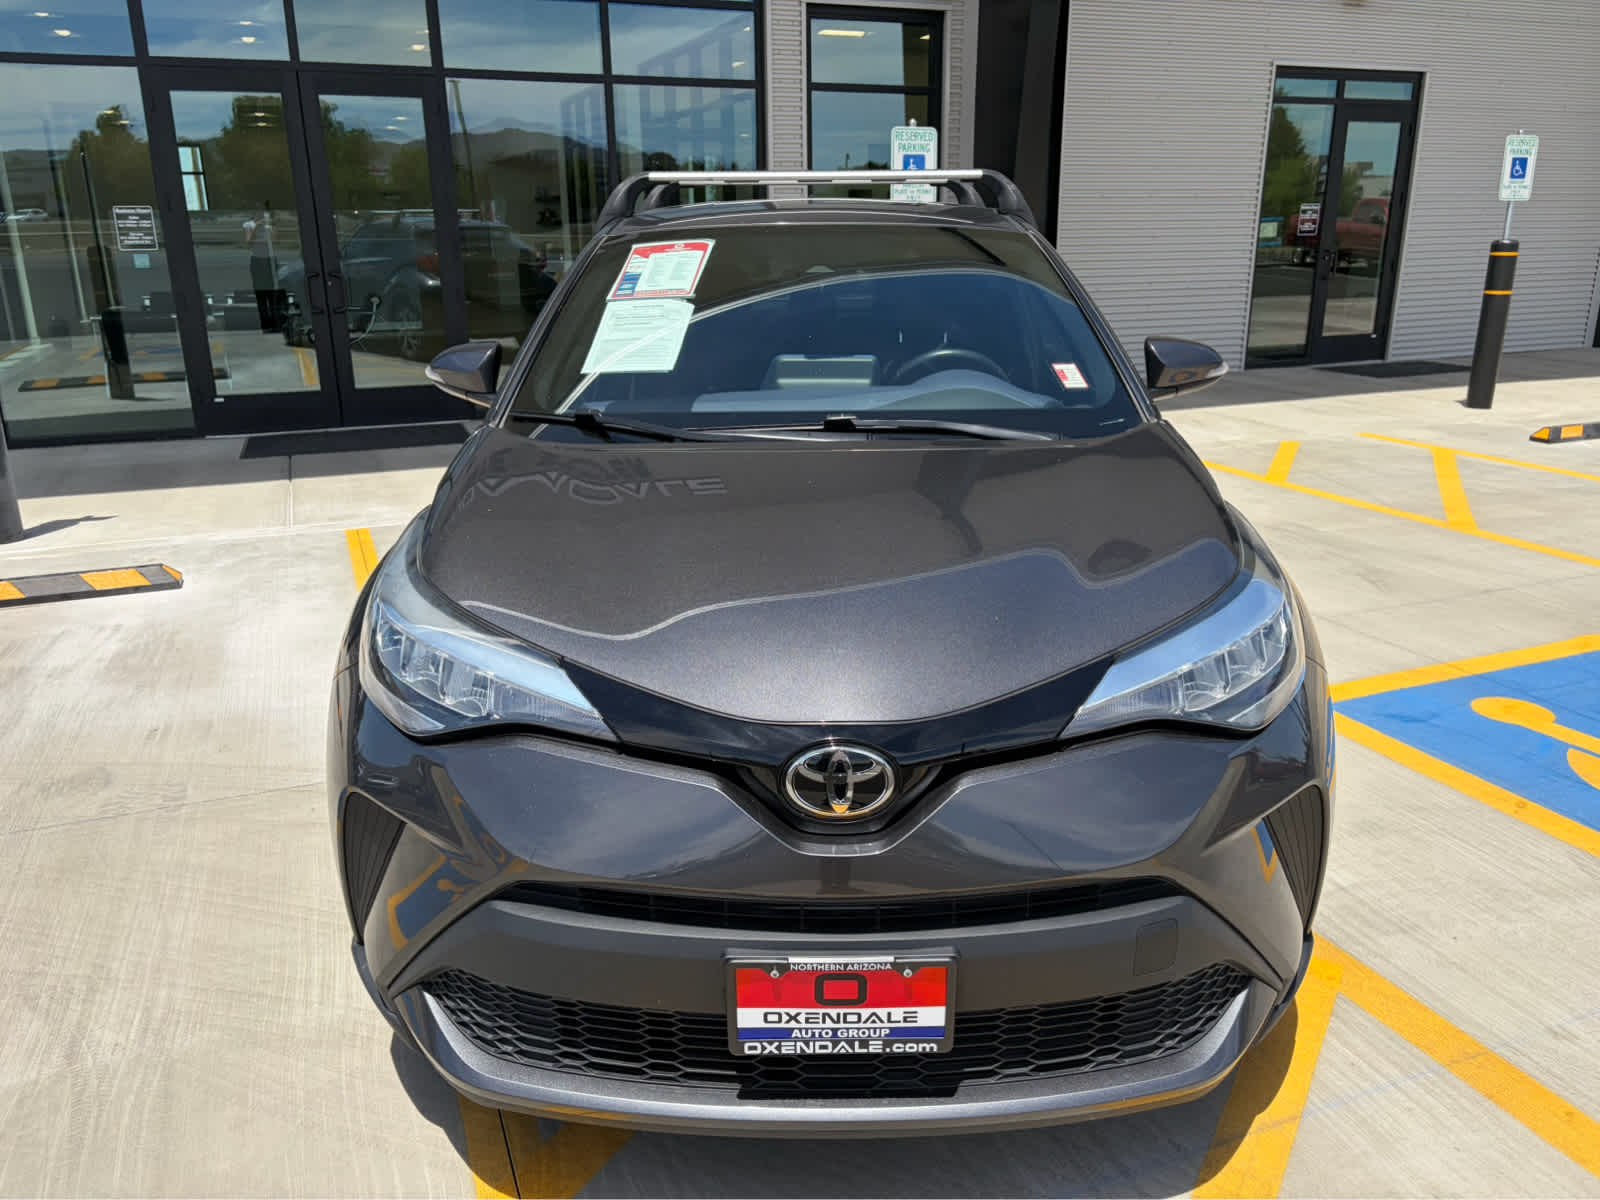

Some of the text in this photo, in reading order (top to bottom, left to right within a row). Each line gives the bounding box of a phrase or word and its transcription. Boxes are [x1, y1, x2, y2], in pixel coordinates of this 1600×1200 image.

[895, 131, 933, 141] RESERVED
[898, 143, 931, 153] PARKING
[789, 962, 893, 972] NORTHERN ARIZONA
[763, 1011, 918, 1025] OXENDALE
[791, 1028, 891, 1039] AUTO GROUP
[743, 1040, 938, 1055] OXENDALE.com
